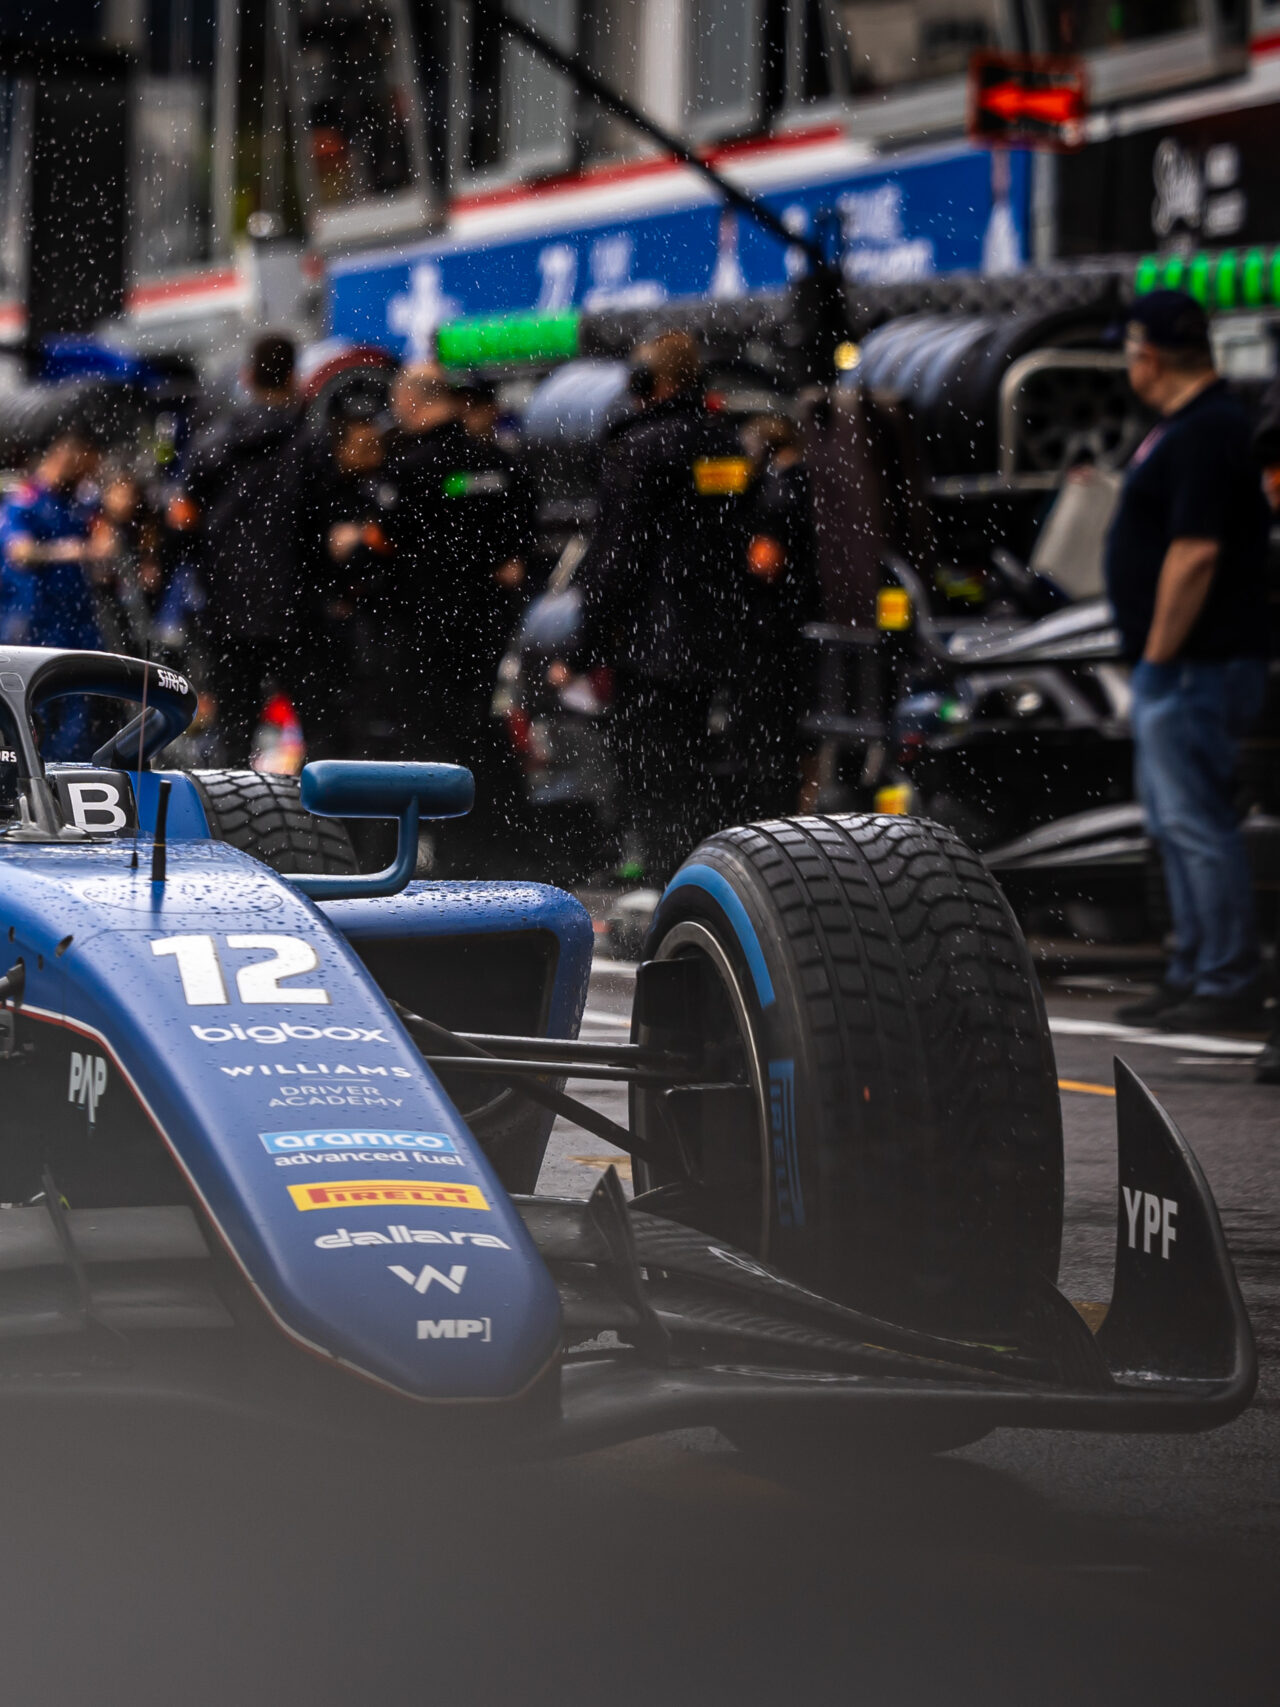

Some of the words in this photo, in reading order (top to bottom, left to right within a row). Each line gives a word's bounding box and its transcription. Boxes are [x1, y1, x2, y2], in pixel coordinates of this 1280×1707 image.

[67, 782, 127, 833] B
[150, 934, 333, 1006] 12
[190, 1022, 391, 1044] bigbox
[220, 1063, 412, 1078] WILLIAMS
[279, 1085, 380, 1097] DRIVER
[269, 1096, 404, 1108] ACADEMY
[274, 1132, 444, 1149] aramco
[275, 1151, 407, 1167] advanced
[412, 1152, 467, 1167] fuel
[306, 1184, 469, 1205] PIRELLI
[1122, 1185, 1178, 1260] YPF
[314, 1225, 512, 1250] dallara
[387, 1264, 468, 1295] W
